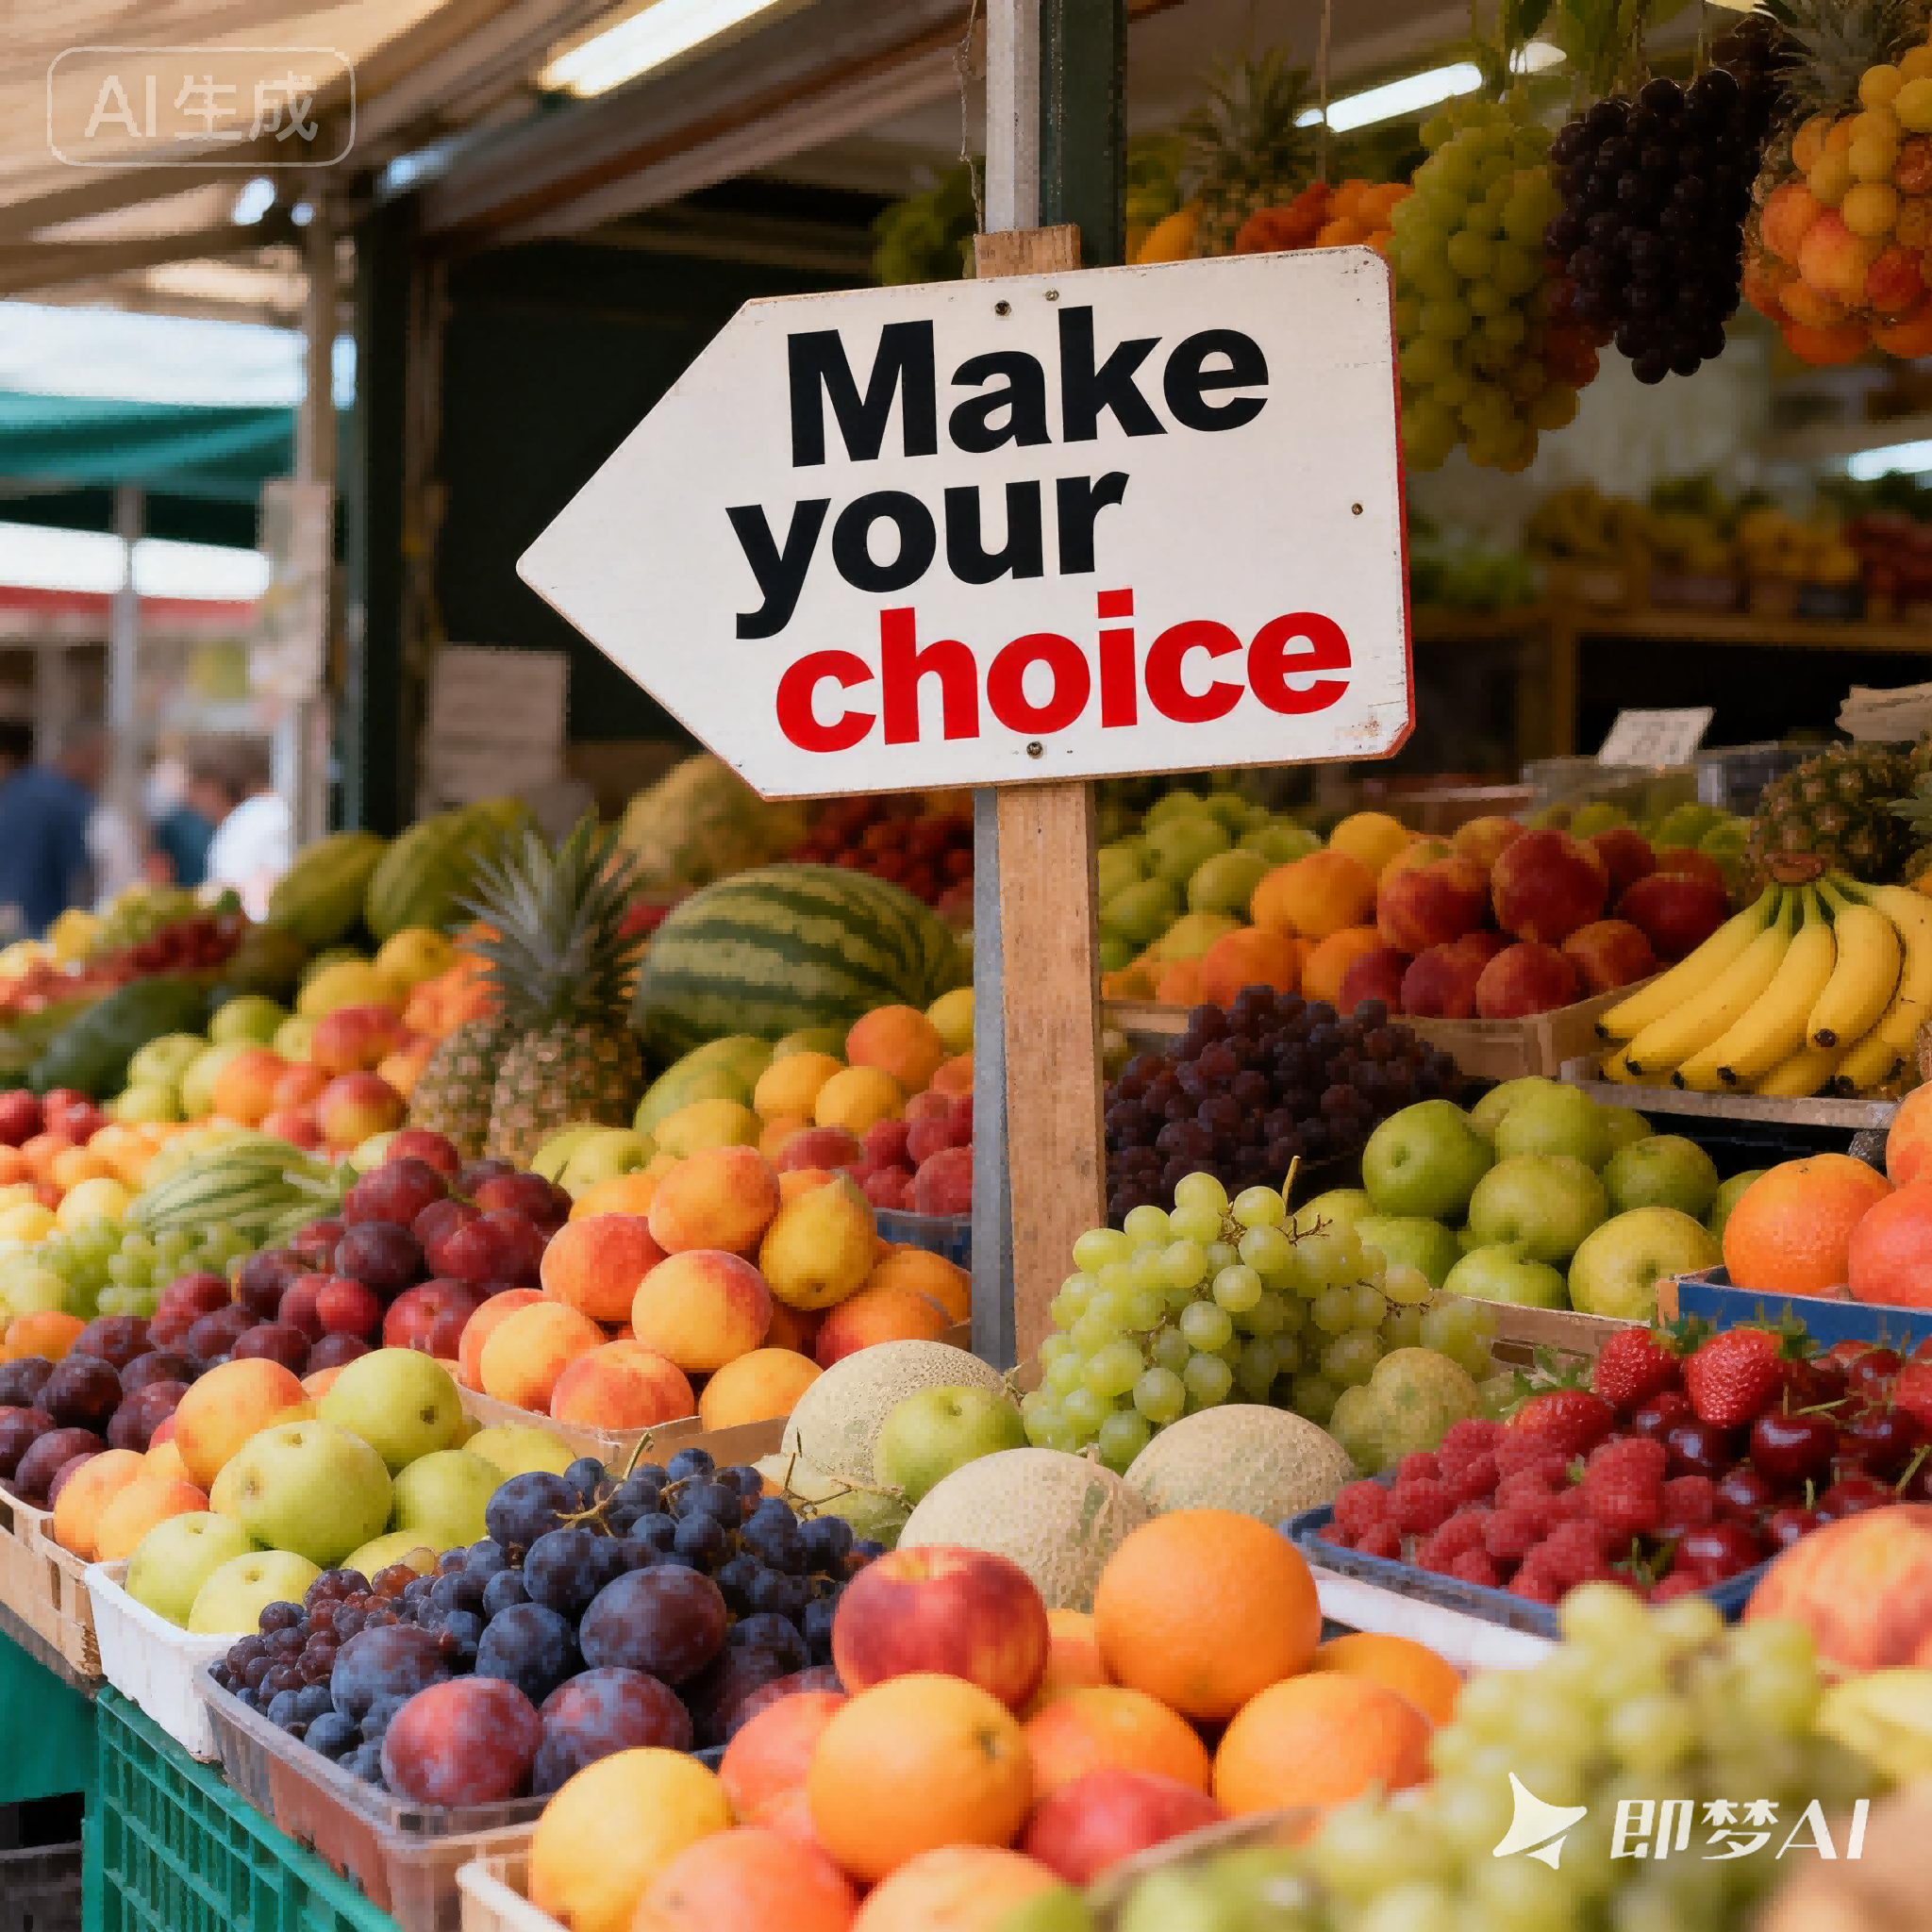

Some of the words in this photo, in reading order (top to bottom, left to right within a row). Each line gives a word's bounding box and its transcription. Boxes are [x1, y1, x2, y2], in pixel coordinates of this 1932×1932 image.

[788, 305, 1269, 468] Make
[725, 471, 1130, 640] your
[775, 589, 1351, 753] choice
